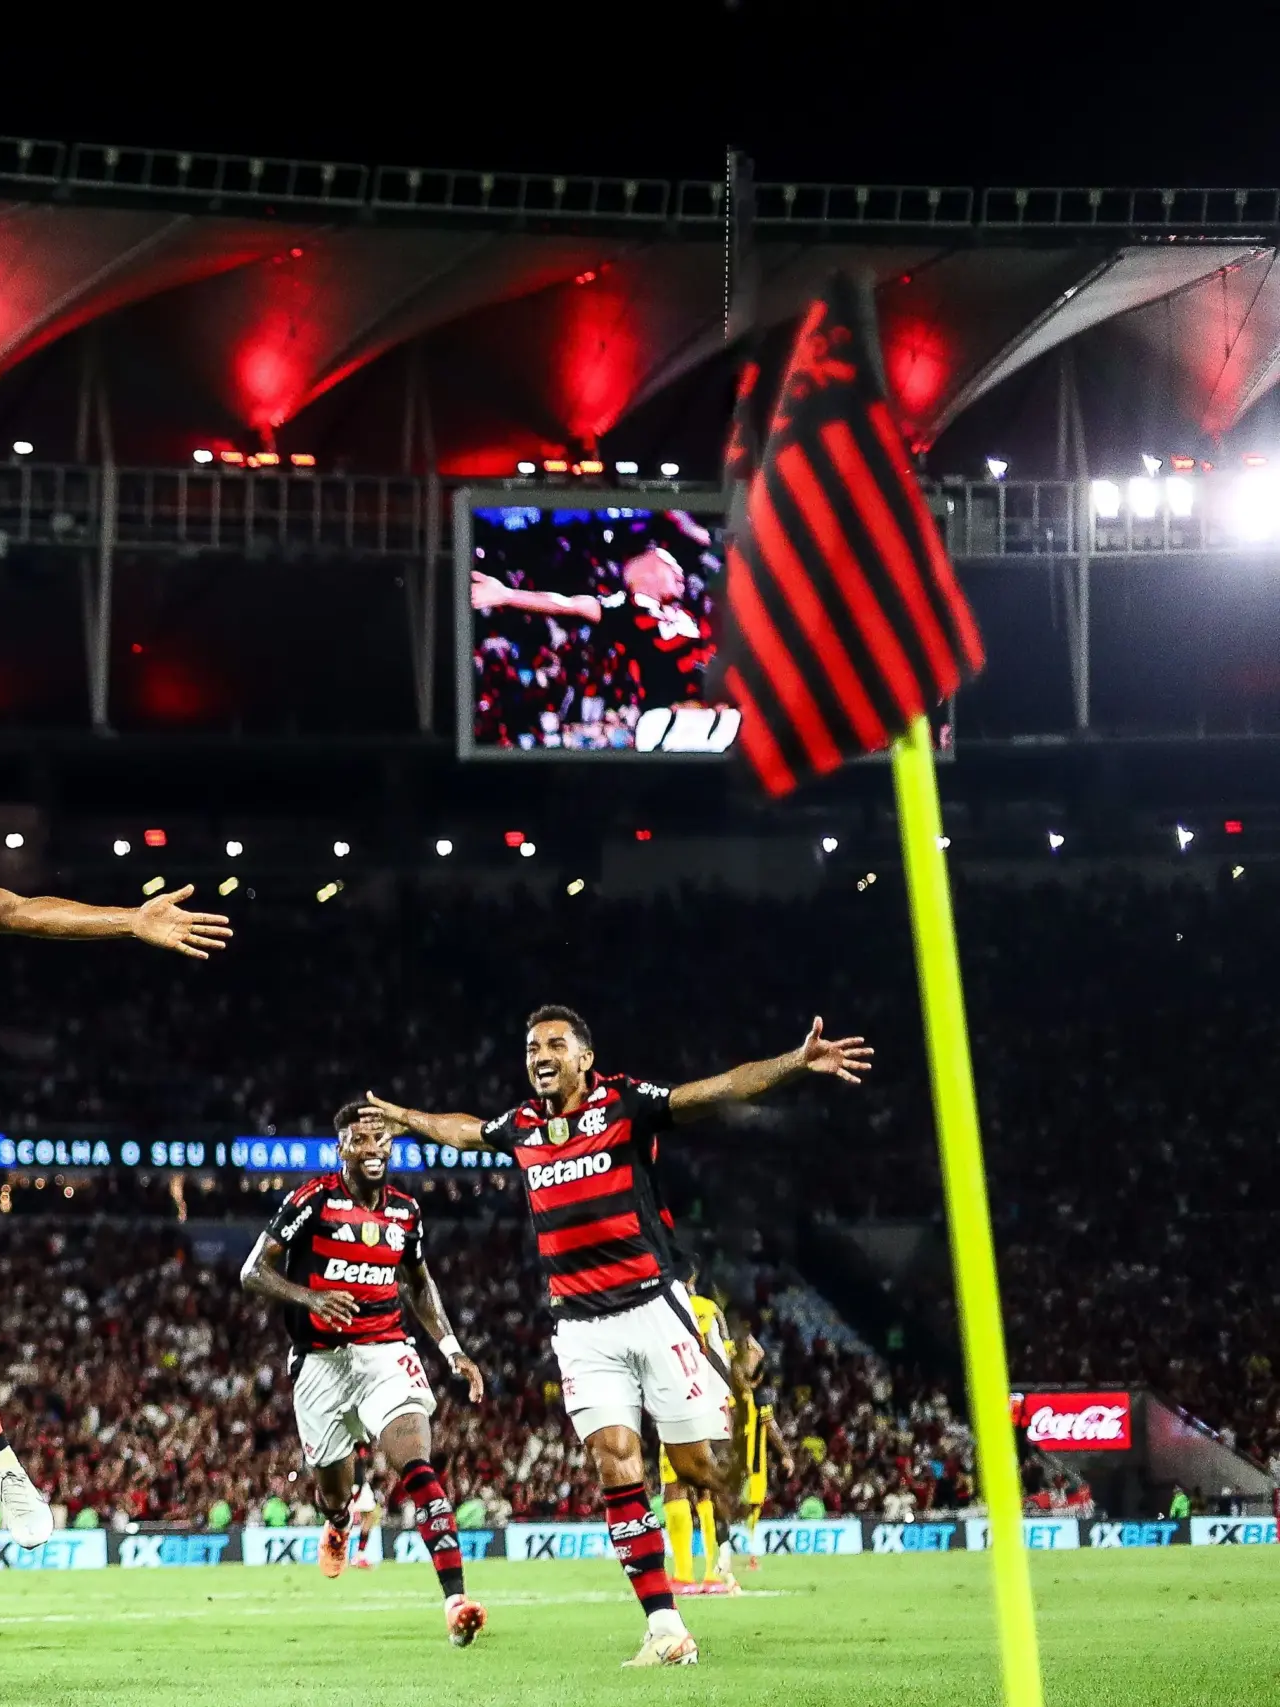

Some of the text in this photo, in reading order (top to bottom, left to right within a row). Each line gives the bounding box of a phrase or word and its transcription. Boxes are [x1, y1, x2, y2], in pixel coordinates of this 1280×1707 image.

[121, 1140, 141, 1167] O
[151, 1140, 205, 1168] SEU
[527, 1152, 613, 1191] Betano
[323, 1257, 396, 1286] Betan
[526, 1531, 608, 1561] 1XBE
[764, 1528, 847, 1555] 1XBET
[871, 1522, 957, 1553] 1XBET
[1089, 1521, 1180, 1549] 1XBET
[1208, 1523, 1277, 1545] 1XBE
[120, 1533, 230, 1568] 1XBET
